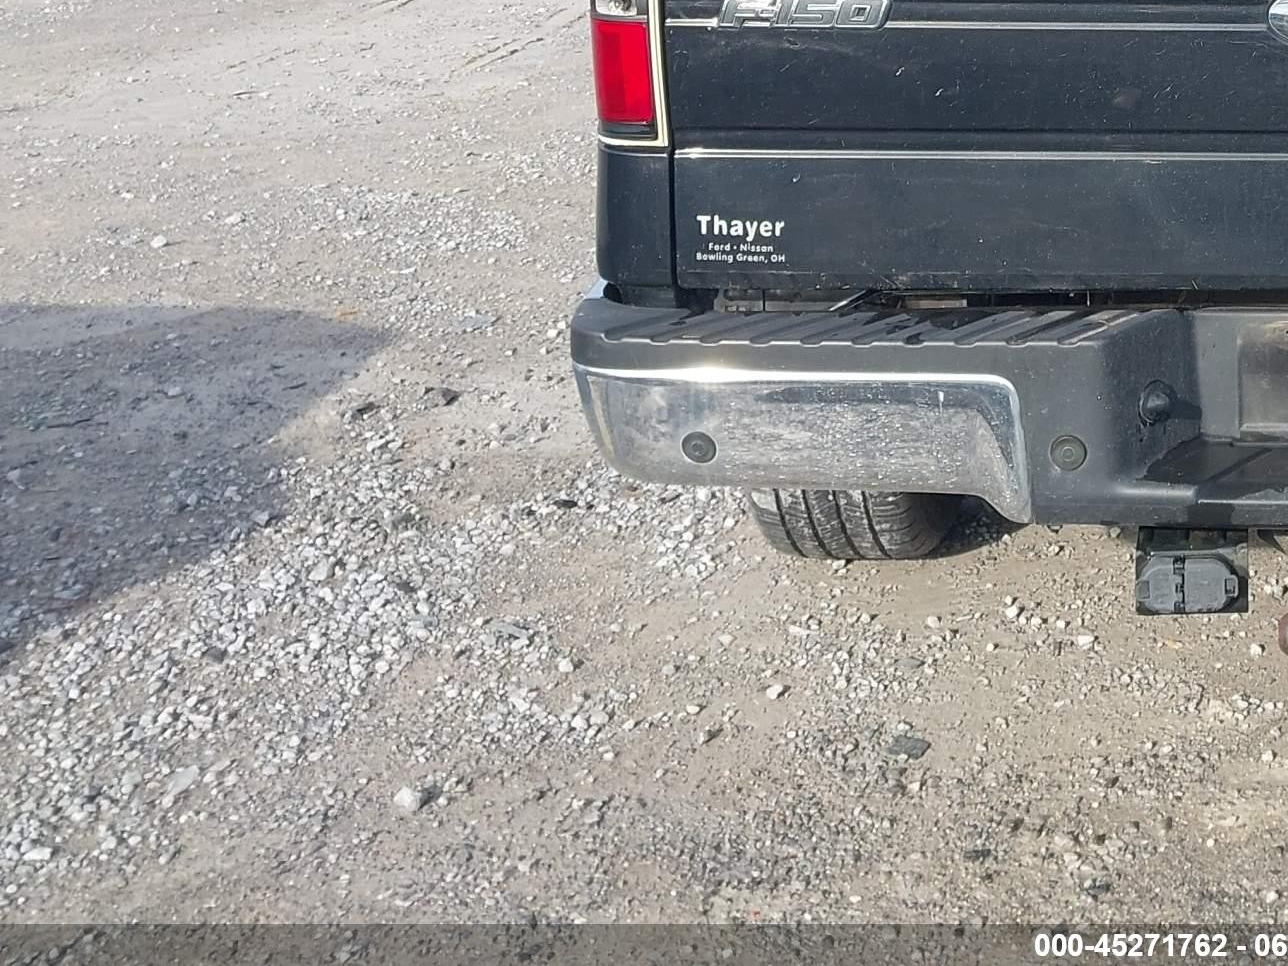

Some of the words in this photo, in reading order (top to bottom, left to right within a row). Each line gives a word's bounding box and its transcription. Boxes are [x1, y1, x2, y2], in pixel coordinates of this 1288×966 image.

[696, 214, 785, 242] Thayer
[708, 242, 731, 251] Ford
[740, 243, 774, 252] Nissan
[696, 252, 734, 264] Bowling
[736, 253, 768, 264] Green,
[771, 254, 785, 263] OH
